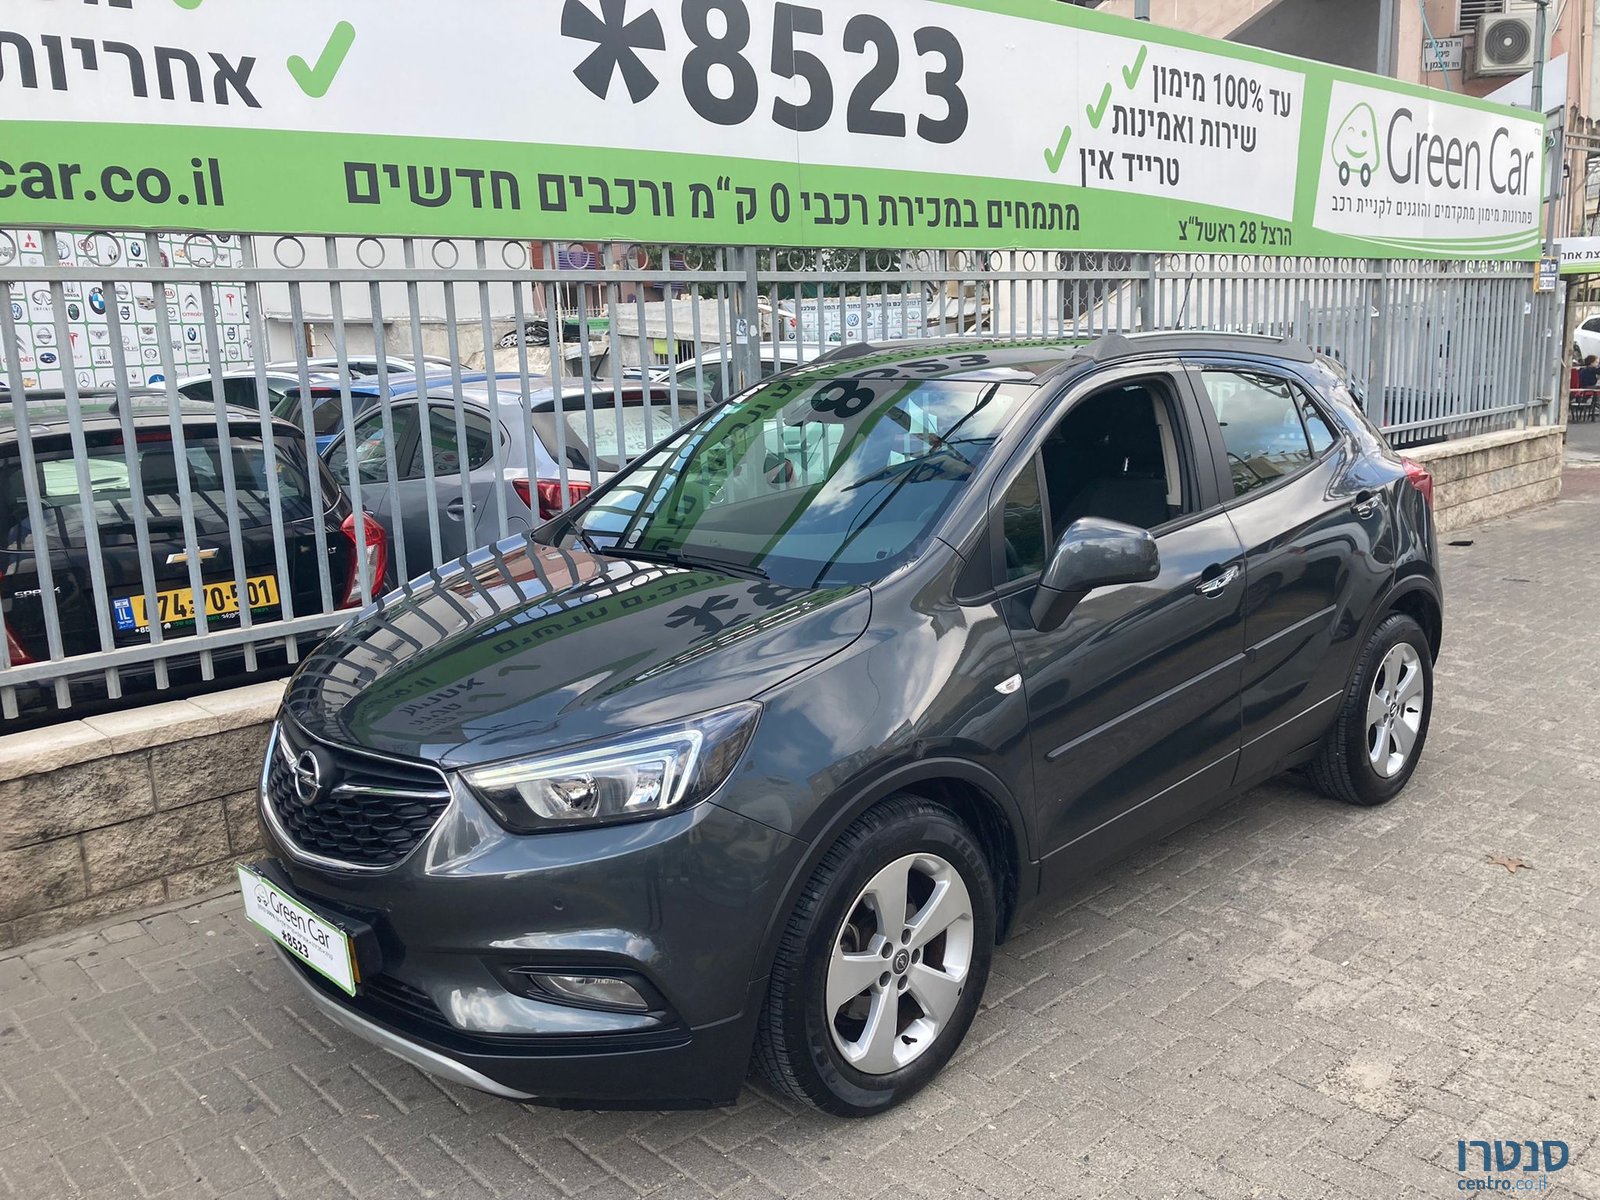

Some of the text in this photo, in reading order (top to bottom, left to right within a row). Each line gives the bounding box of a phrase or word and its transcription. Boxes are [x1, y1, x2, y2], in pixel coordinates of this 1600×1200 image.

[0, 31, 262, 109] אחריות
[1153, 65, 1292, 118] עד 100% מימון
[1112, 105, 1257, 153] שירות ואמינות
[1080, 148, 1180, 188] טרייד אין
[1387, 107, 1534, 197] Green Car
[343, 161, 521, 210] חדשים
[537, 173, 675, 217] ורכבים
[770, 182, 790, 223] 0
[800, 191, 869, 226] רכבי
[878, 195, 979, 228] במכירת
[987, 199, 1080, 231] מתמחים
[1332, 195, 1533, 225] פתרונות מימון מתקדמים והוגנים לקניית רכב
[1239, 220, 1257, 244] 28
[1260, 221, 1292, 246] הרצל
[14, 586, 61, 599] SPAK
[142, 579, 271, 621] 74-0-501
[270, 891, 306, 934] Green
[308, 918, 330, 949] Car
